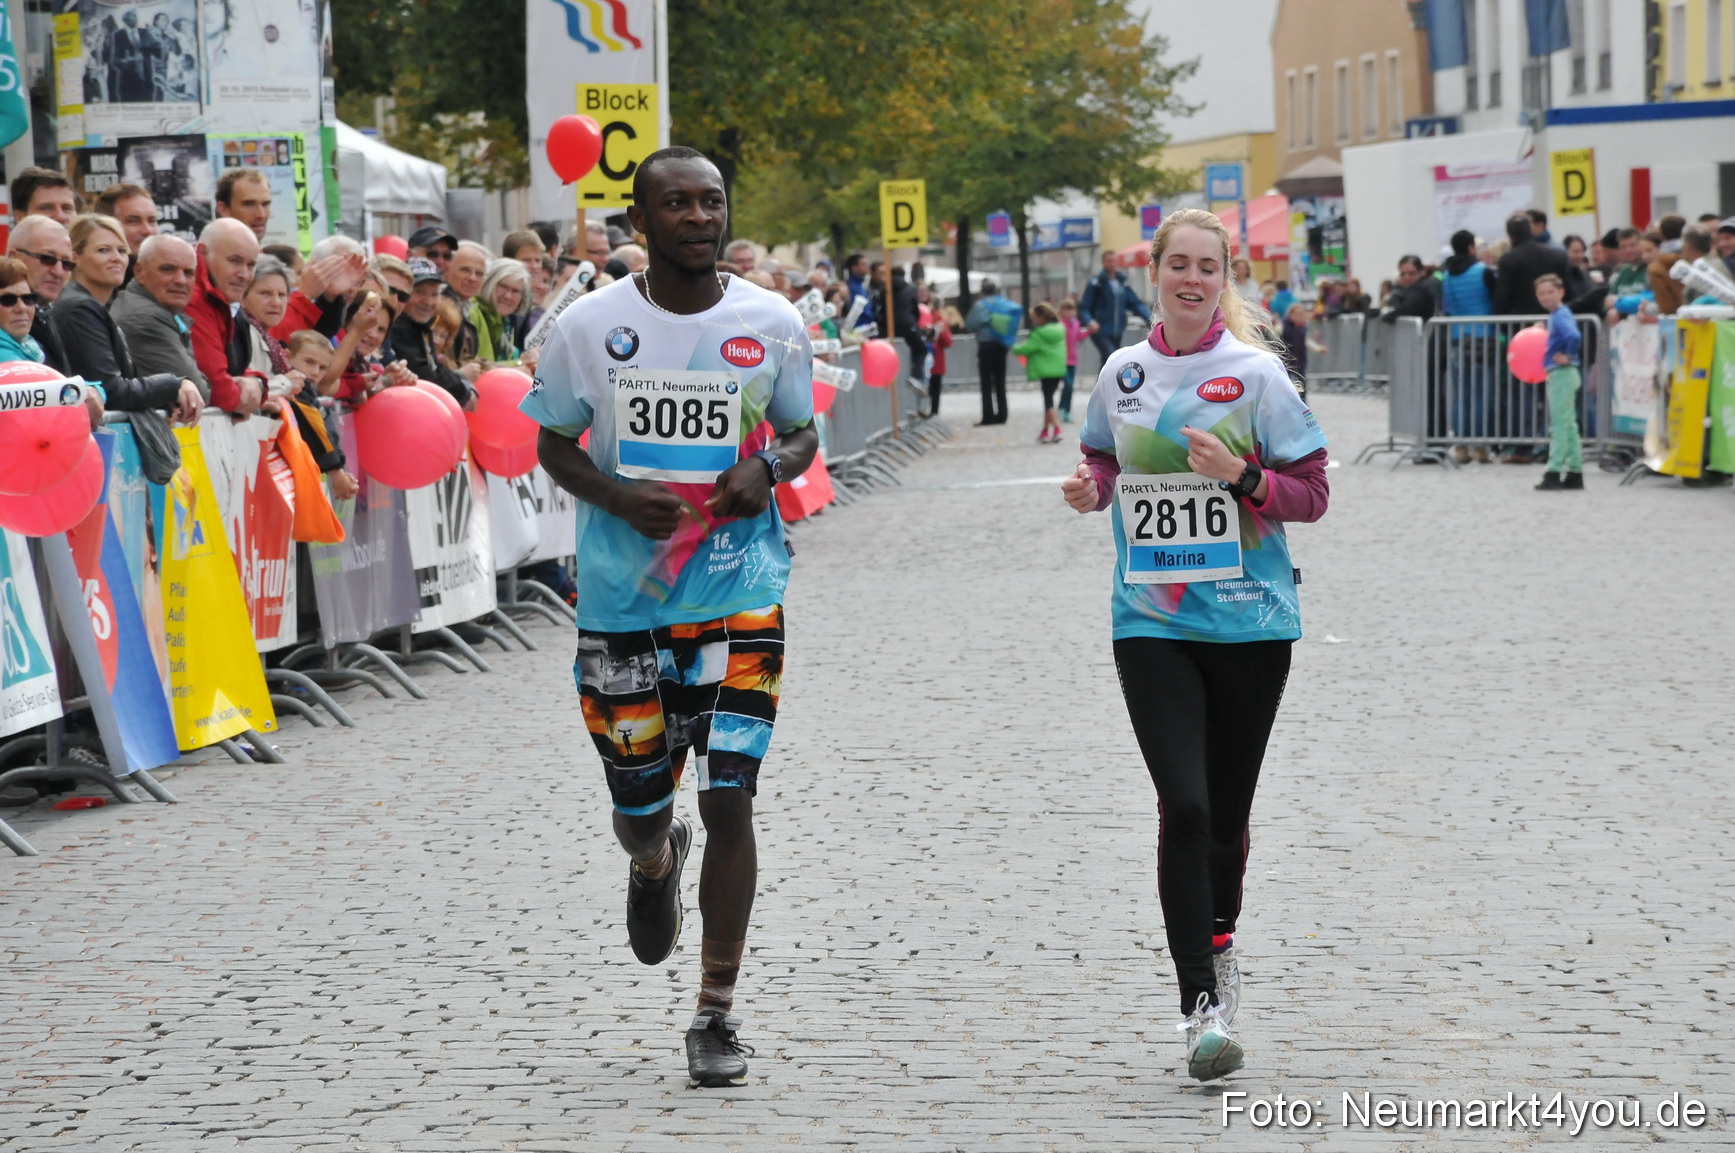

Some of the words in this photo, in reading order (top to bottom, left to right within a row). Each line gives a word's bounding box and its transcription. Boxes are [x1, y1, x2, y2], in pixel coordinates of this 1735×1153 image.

[586, 89, 649, 111] Block
[598, 121, 637, 182] C
[886, 184, 918, 197] Block
[1563, 170, 1586, 201] D
[894, 201, 914, 232] D
[607, 327, 638, 340] BMW
[727, 344, 761, 361] Hervis
[619, 379, 659, 392] PARTL
[662, 382, 720, 393] Neumarkt
[1202, 383, 1239, 396] Hervis
[1117, 398, 1142, 408] PARTL
[629, 397, 729, 440] 3085
[1121, 484, 1159, 494] PARTL
[1160, 482, 1214, 492] Neumarkt
[1134, 497, 1228, 539] 2816
[713, 532, 733, 550] 16.
[1154, 550, 1206, 567] Marina
[1217, 591, 1265, 603] Stadtlauf
